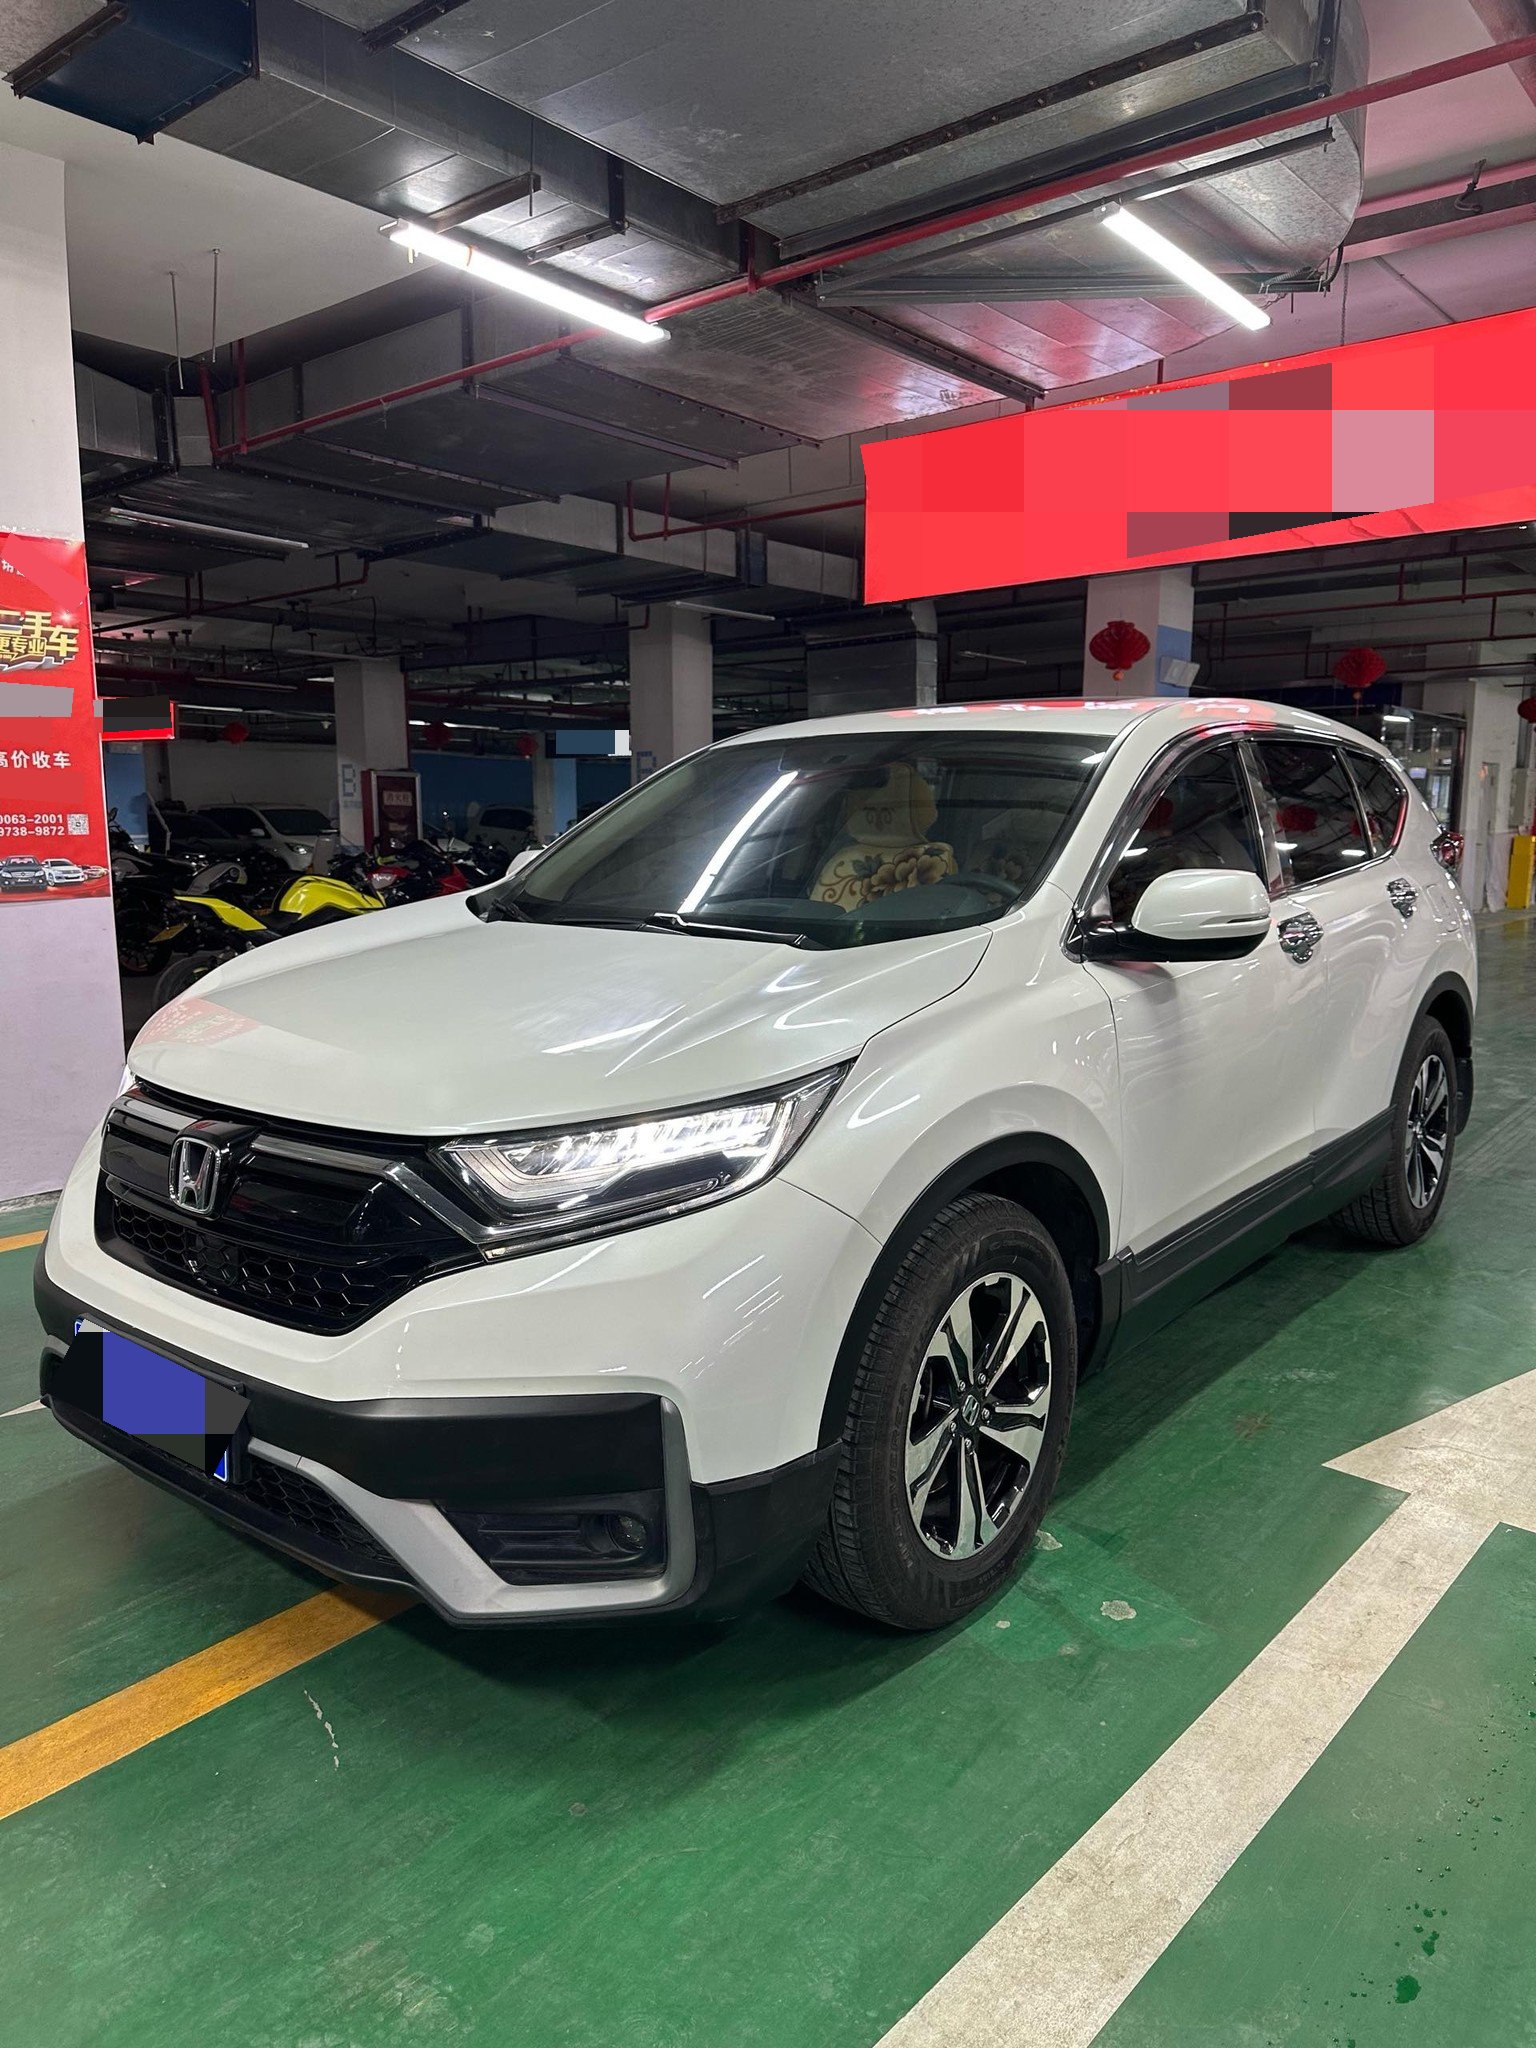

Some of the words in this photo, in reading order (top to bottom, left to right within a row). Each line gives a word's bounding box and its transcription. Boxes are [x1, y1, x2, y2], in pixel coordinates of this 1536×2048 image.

[0, 610, 79, 656] 二手车
[0, 637, 44, 654] 更专业
[0, 826, 65, 836] 9738-9872
